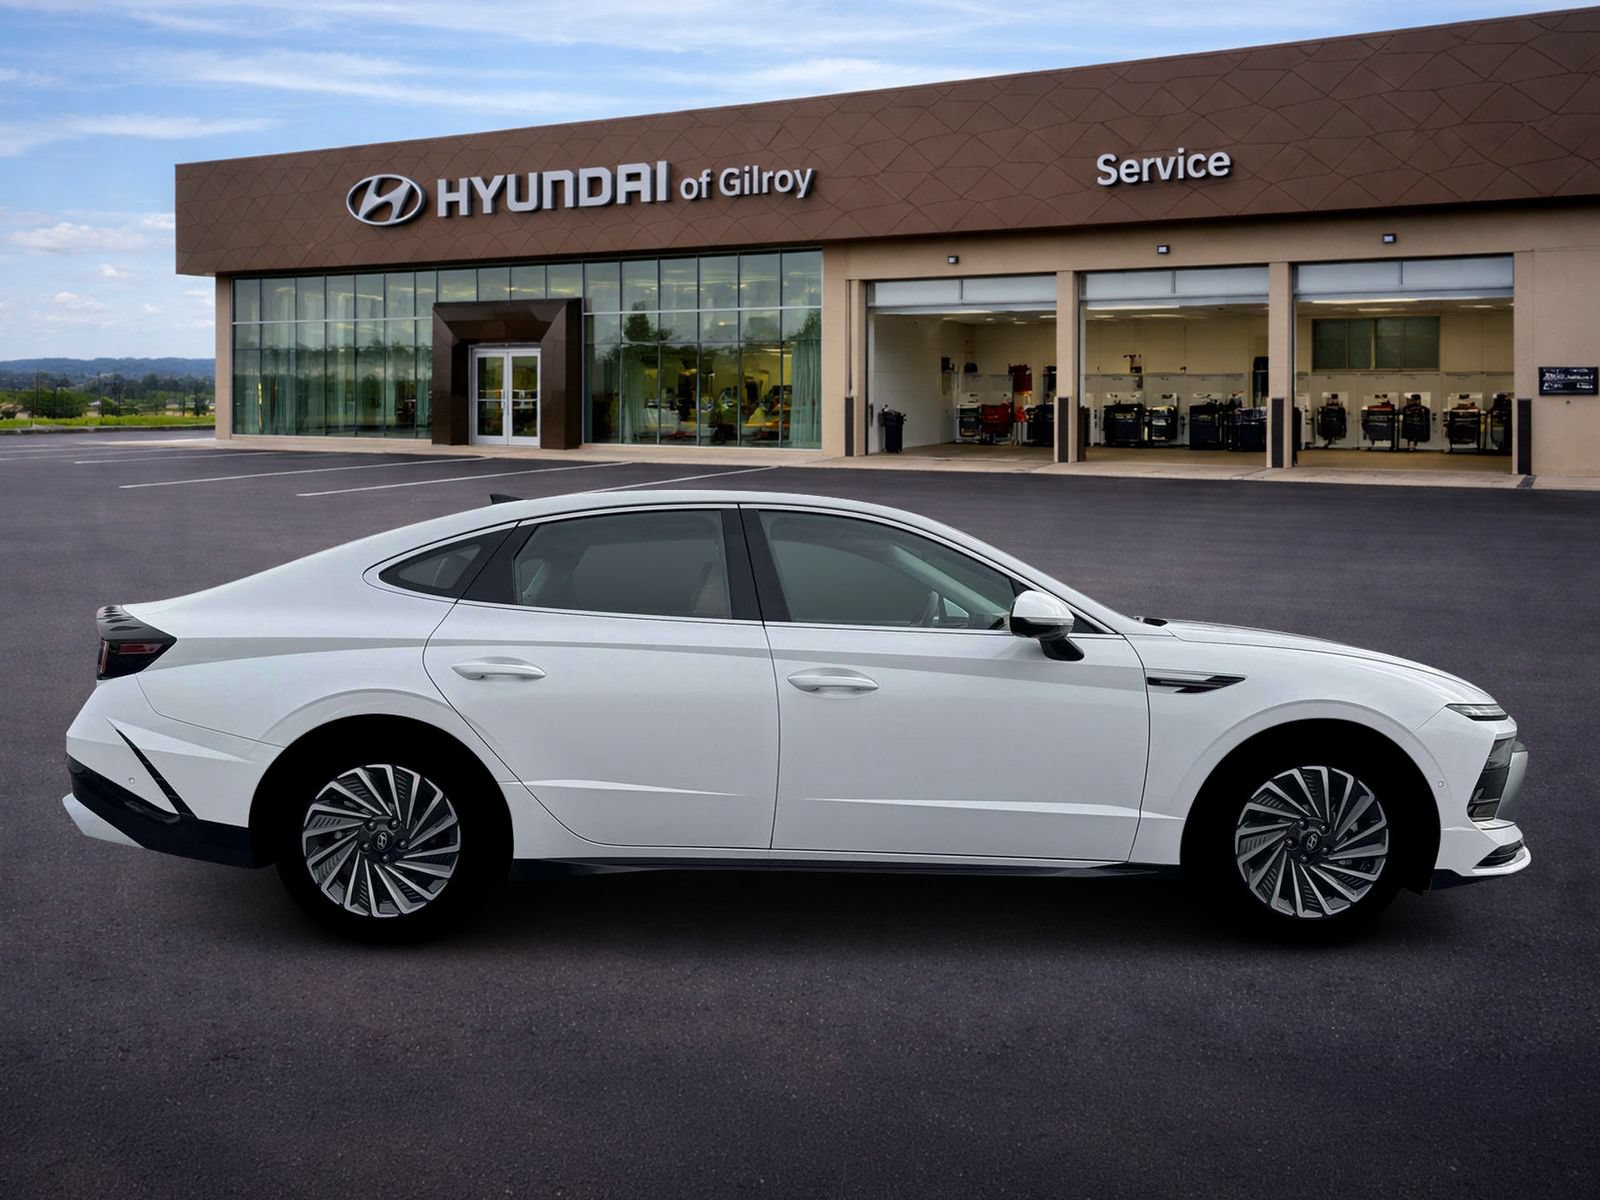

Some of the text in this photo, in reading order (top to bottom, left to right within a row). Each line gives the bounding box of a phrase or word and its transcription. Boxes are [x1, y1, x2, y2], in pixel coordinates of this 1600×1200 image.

[436, 160, 814, 217] HYUNDAI of Gilroy
[1095, 147, 1233, 186] Service
